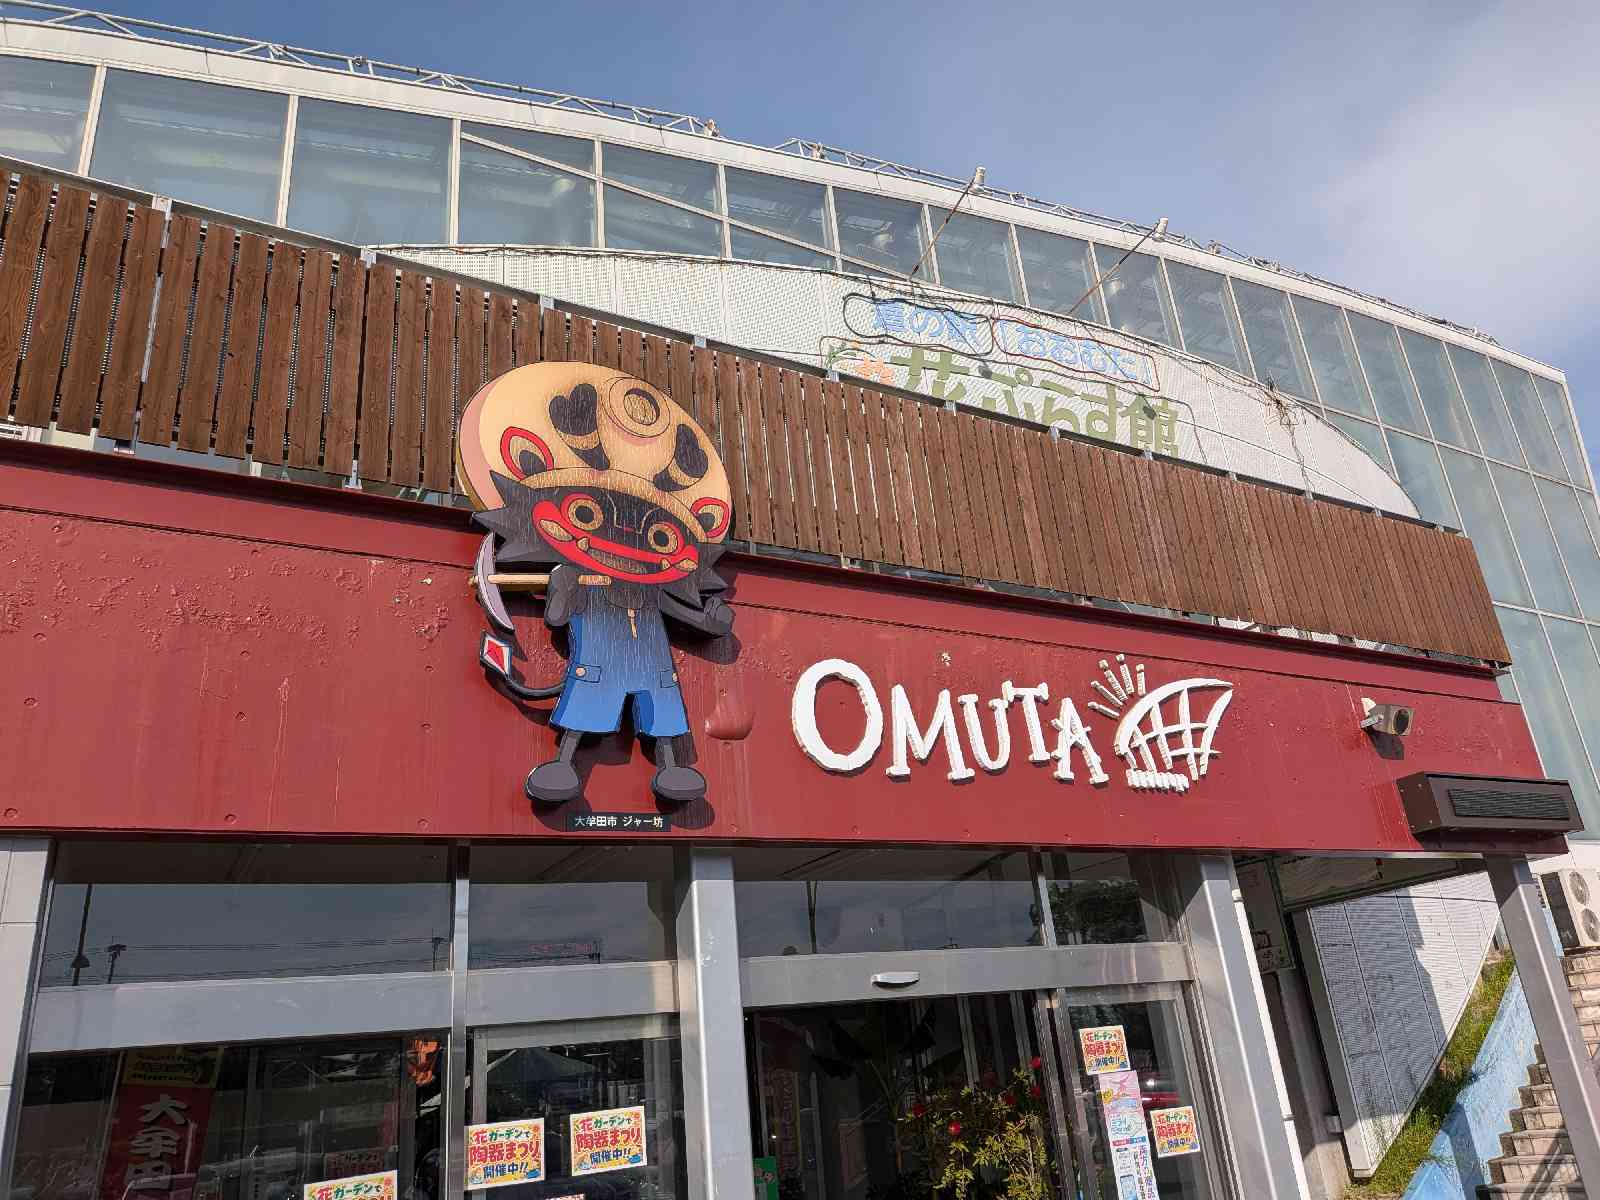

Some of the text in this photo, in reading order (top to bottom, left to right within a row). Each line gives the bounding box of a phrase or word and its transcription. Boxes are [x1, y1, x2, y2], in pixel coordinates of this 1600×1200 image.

[792, 659, 1108, 784] OMUTA
[574, 815, 664, 828] 大牟田市 ジャー坊
[575, 1127, 642, 1152] 陶器まつり
[469, 1140, 541, 1165] 陶器まつり
